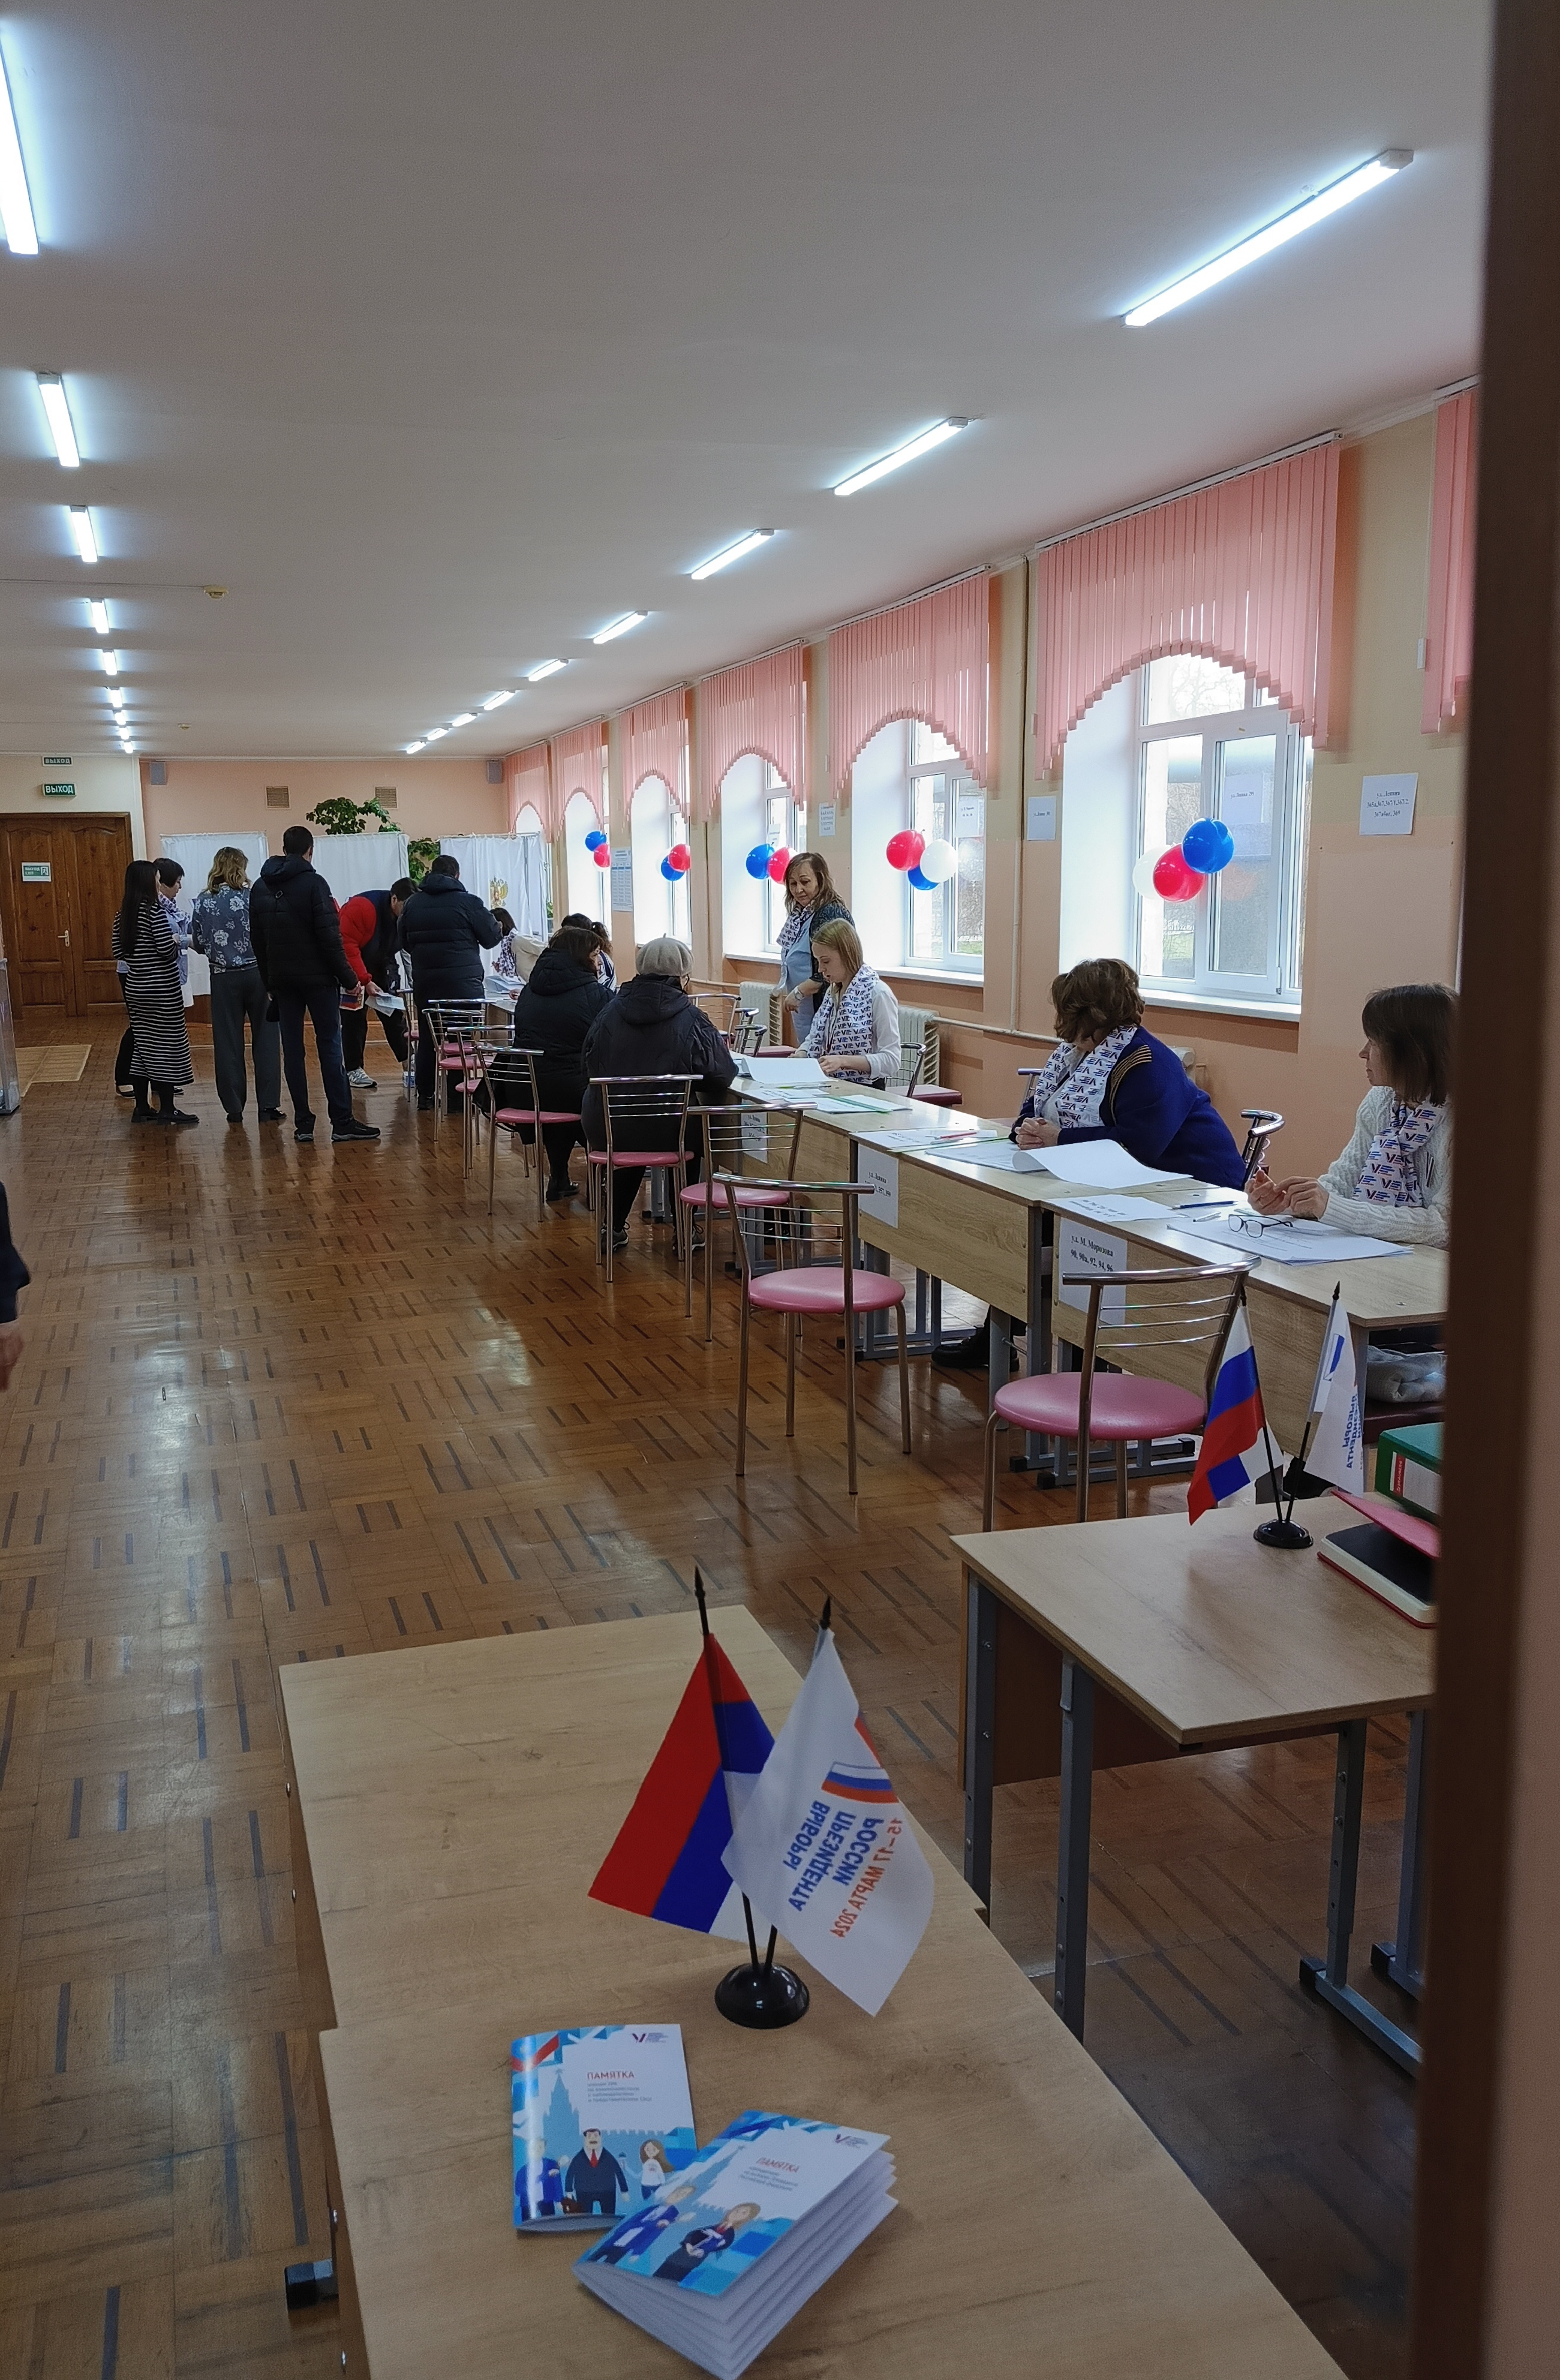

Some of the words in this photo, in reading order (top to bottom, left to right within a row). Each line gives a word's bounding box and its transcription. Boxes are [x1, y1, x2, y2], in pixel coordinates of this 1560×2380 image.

[45, 785, 74, 794] ВЫХОД
[1080, 1236, 1087, 1246] М.
[1087, 1239, 1113, 1257] Морозова
[587, 2071, 635, 2080] ПАМЯТКА
[756, 2157, 799, 2173] ПАМЯТКА
